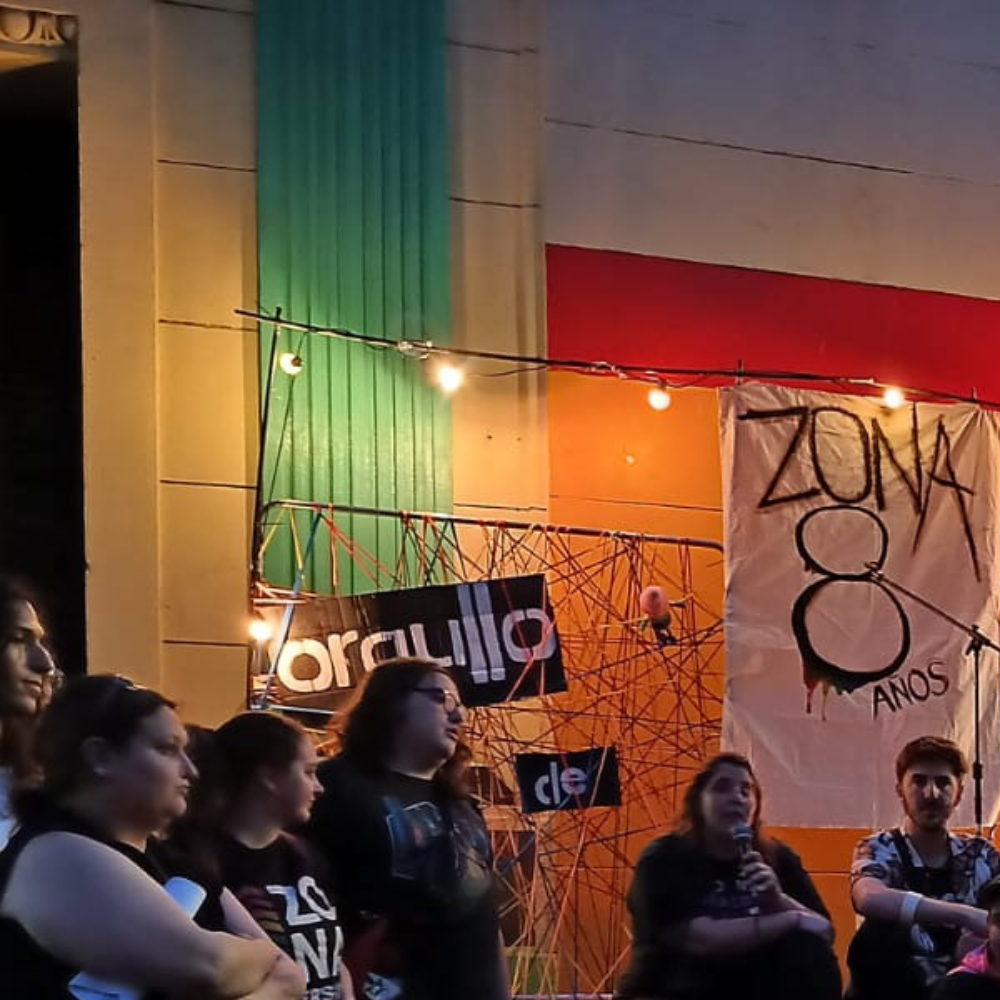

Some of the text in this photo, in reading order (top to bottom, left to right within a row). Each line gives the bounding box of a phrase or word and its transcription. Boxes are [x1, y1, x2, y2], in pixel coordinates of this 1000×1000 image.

[737, 401, 982, 583] ZONA
[792, 505, 911, 694] 8
[534, 761, 588, 806] de
[266, 875, 338, 926] ZO
